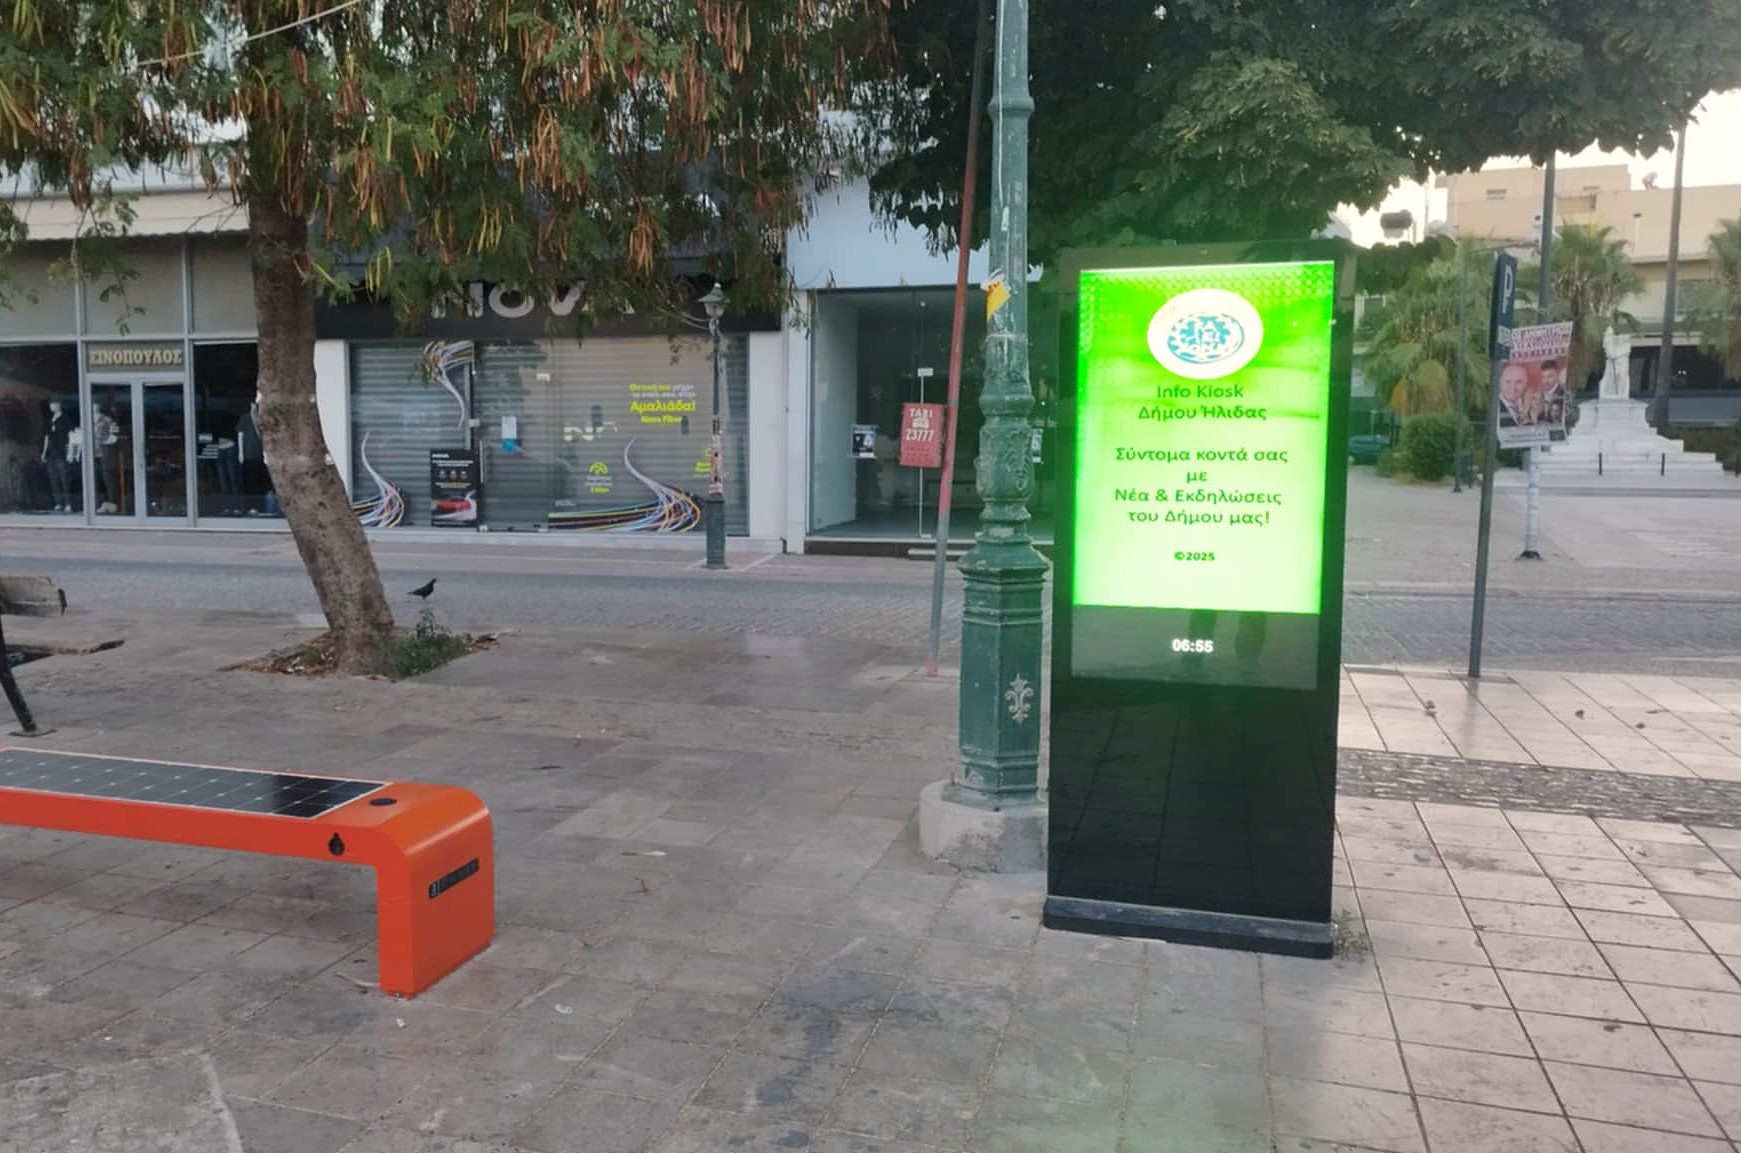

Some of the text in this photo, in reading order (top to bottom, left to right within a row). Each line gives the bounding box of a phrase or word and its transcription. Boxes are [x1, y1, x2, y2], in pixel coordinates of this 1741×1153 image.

[1502, 265, 1514, 314] P
[89, 349, 182, 365] ΣΙΝΟΠΟΥΛΟΣ
[1157, 384, 1244, 399] Info Kiosk
[1138, 406, 1197, 422] Δήμου
[1115, 448, 1288, 463] Σύντομα κοντά σας
[1186, 472, 1208, 484] με
[1114, 488, 1282, 505] Νέα & Εκδηλώσεις
[1128, 509, 1270, 526] του Δήμου μας!
[1172, 638, 1214, 653] 06:55
